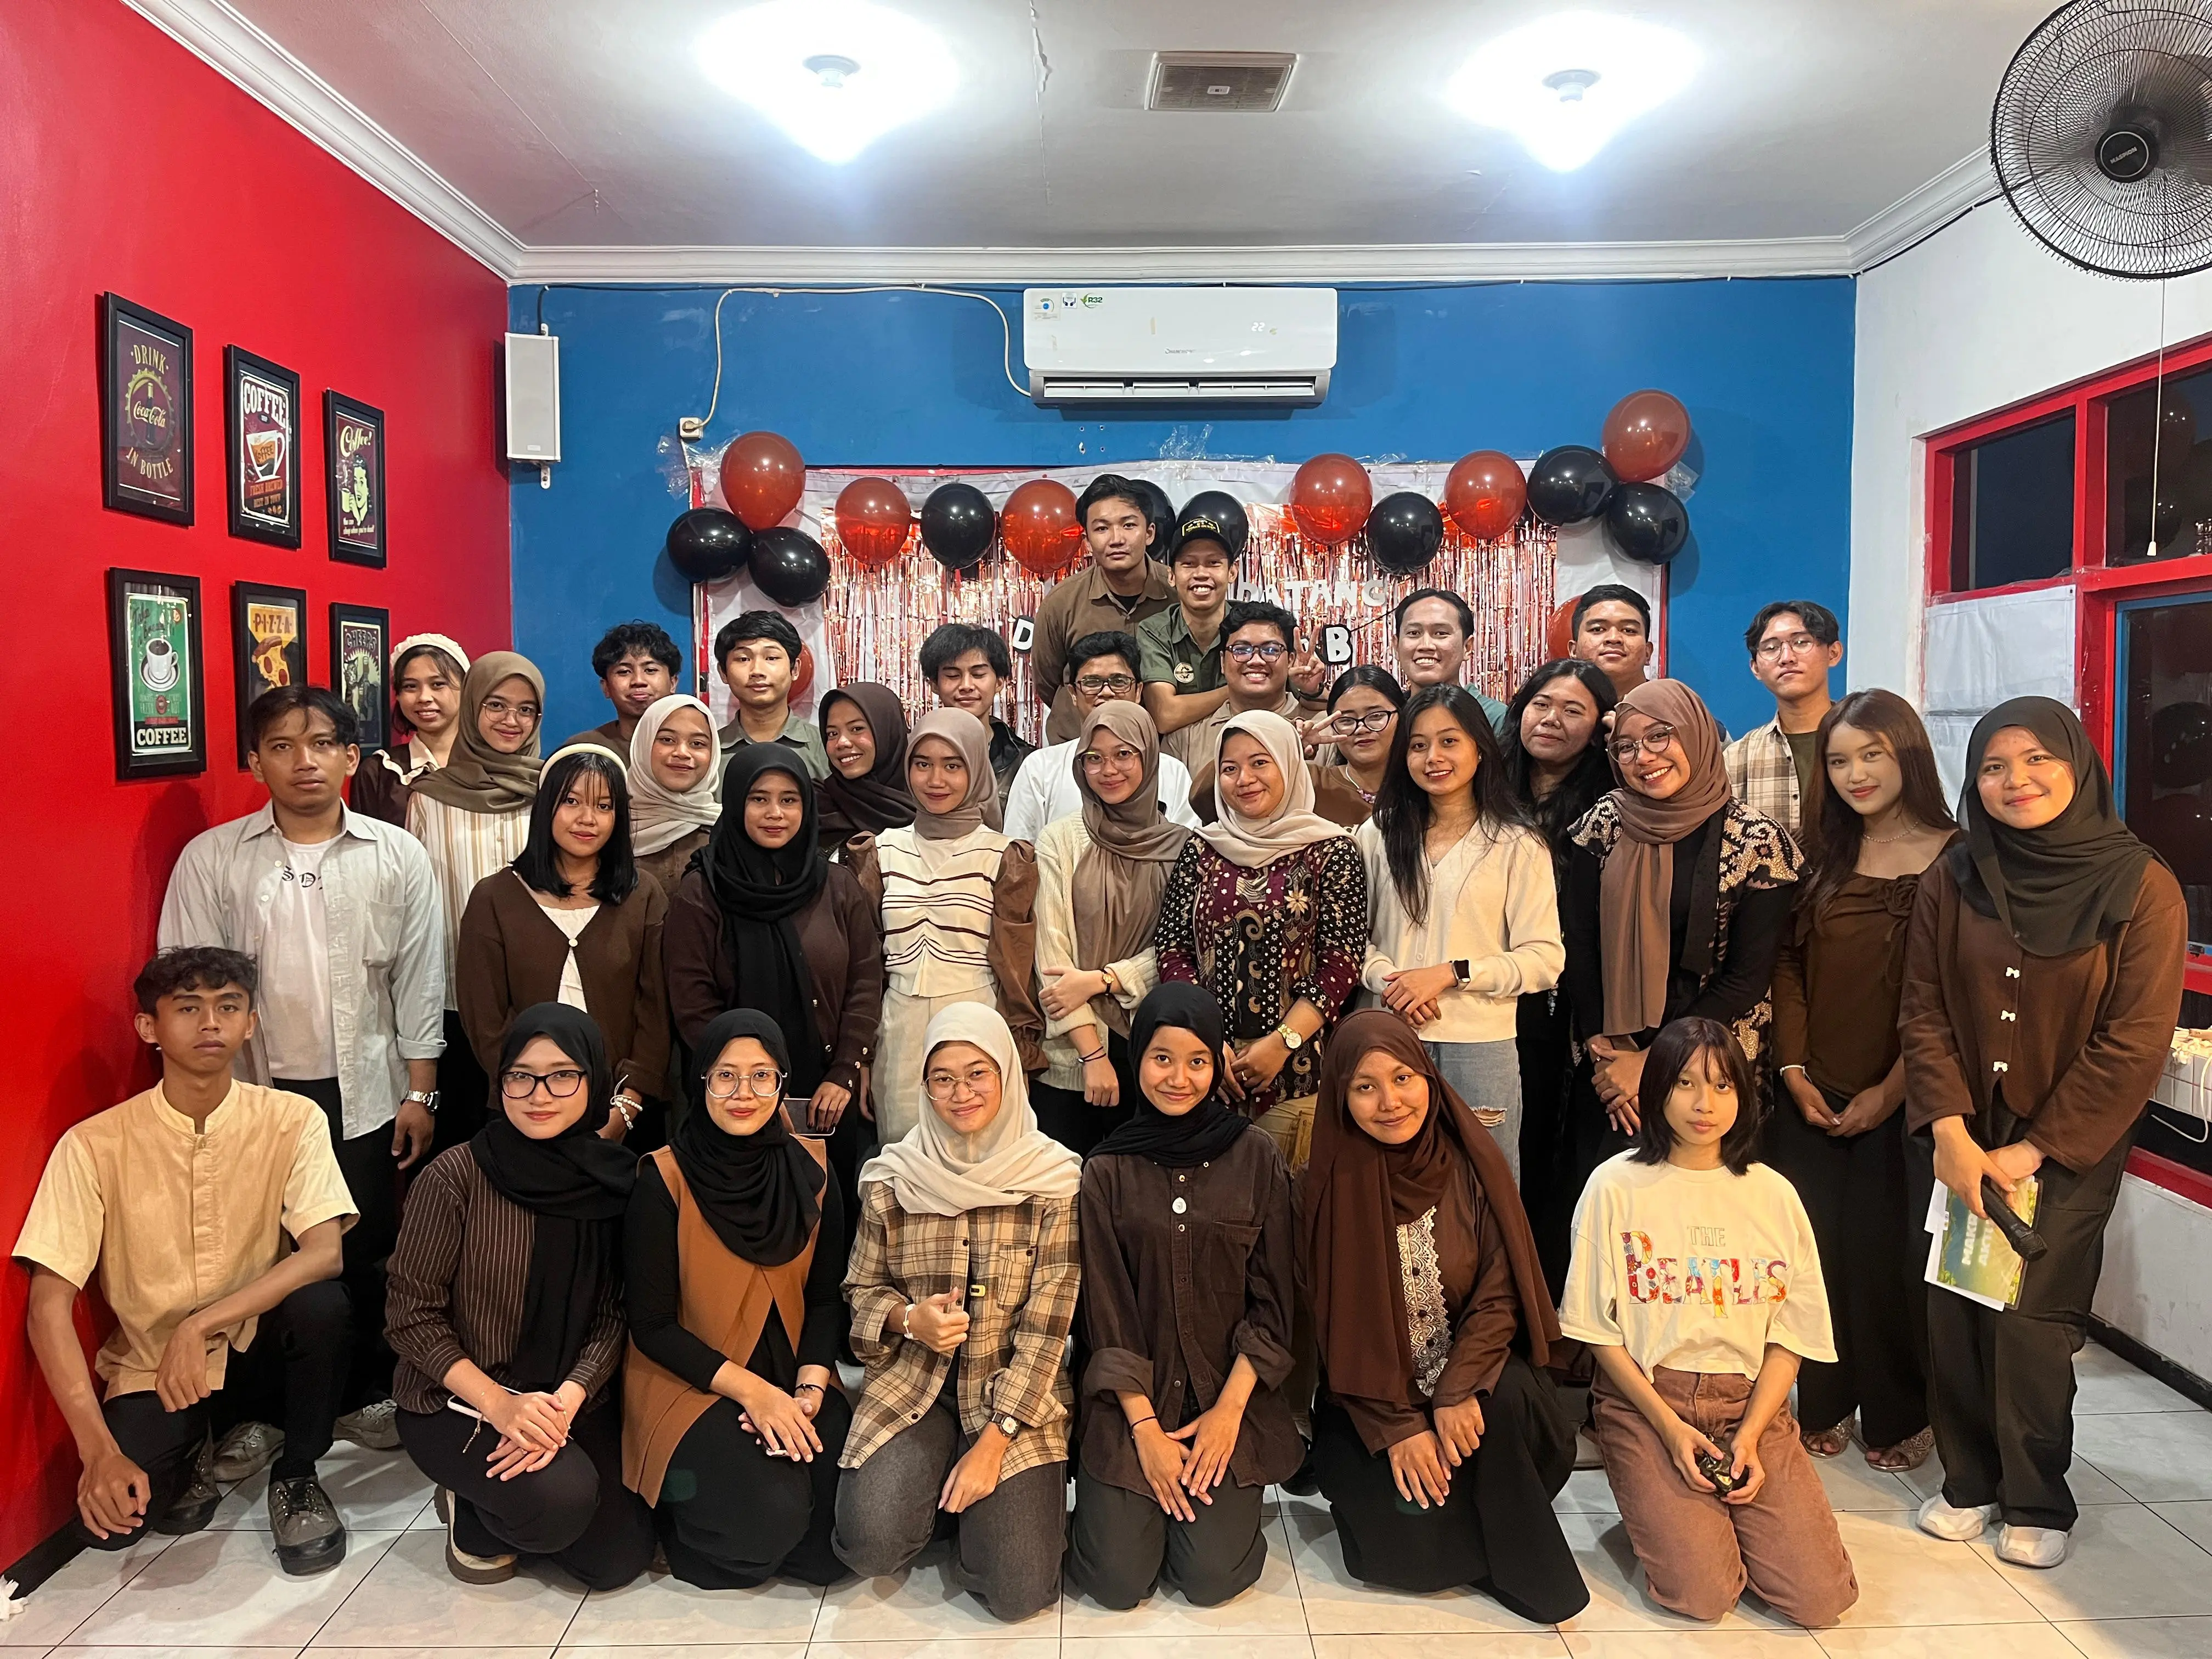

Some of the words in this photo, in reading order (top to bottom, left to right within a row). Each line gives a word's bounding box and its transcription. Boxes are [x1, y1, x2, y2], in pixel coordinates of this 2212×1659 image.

[2110, 146, 2137, 164] MASPION
[133, 345, 166, 374] DRINK
[244, 382, 286, 428] COFFEE
[340, 426, 372, 458] Coffee!
[126, 447, 139, 467] IN
[140, 458, 173, 479] BOTTLE
[1236, 579, 1386, 610] DATANG
[346, 629, 377, 652] CHEERS
[137, 727, 187, 746] COFFEE
[1686, 1226, 1726, 1247] THE
[1620, 1231, 1790, 1318] BEATLES
